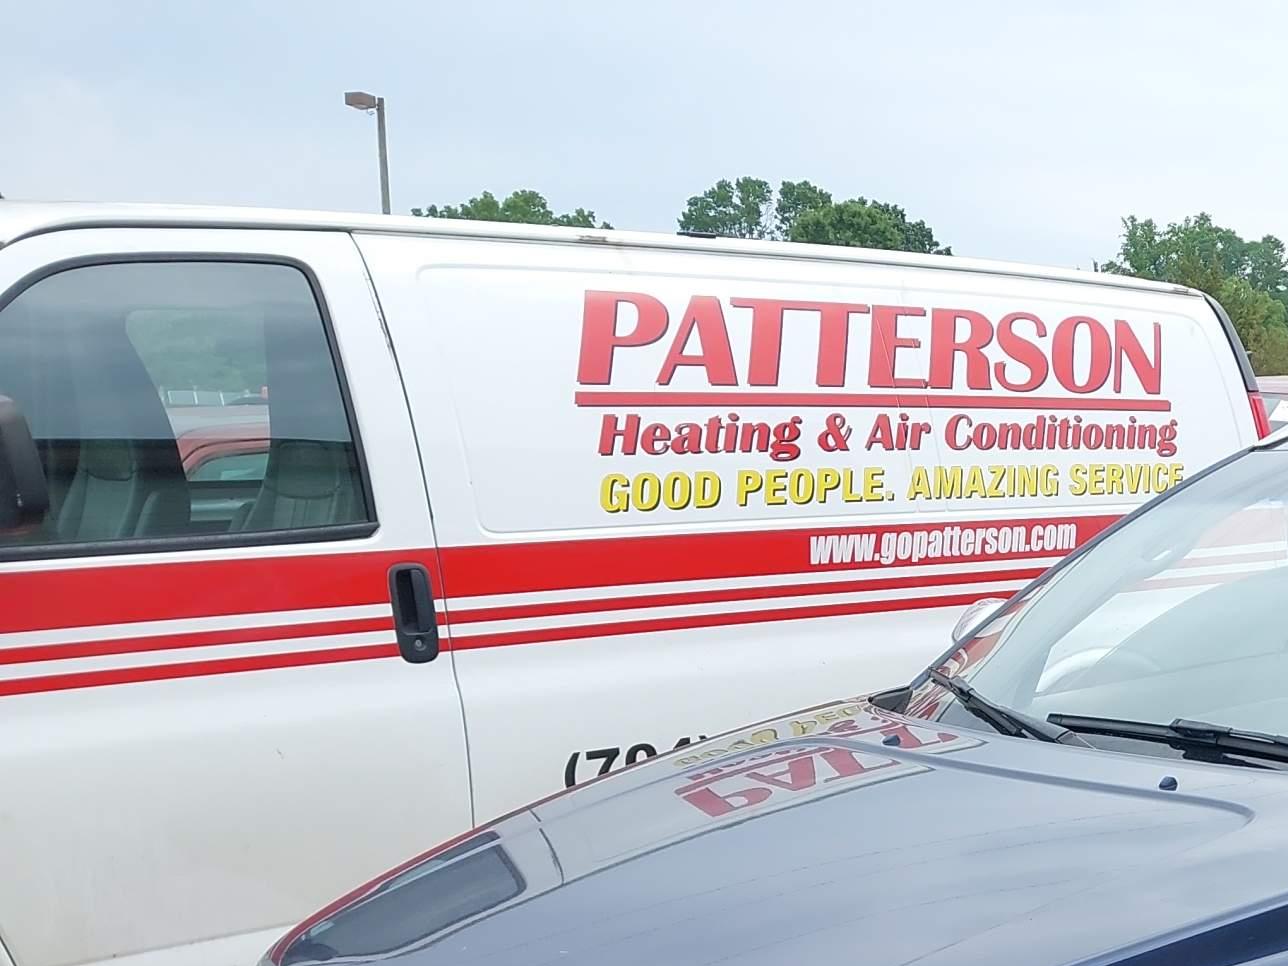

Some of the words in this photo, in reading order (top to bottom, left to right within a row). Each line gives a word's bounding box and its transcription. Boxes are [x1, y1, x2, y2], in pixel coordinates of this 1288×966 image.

[576, 290, 1163, 395] PATTERSON
[598, 412, 801, 460] Heating
[817, 413, 852, 452] &
[865, 414, 931, 452] Air
[945, 415, 1178, 457] Conditioning
[600, 471, 721, 513] GOOD
[736, 467, 895, 508] PEOPLE.
[907, 464, 1059, 500] AMAZING
[1069, 463, 1184, 496] SERVICE
[810, 523, 1077, 566] www.gopatterson.com
